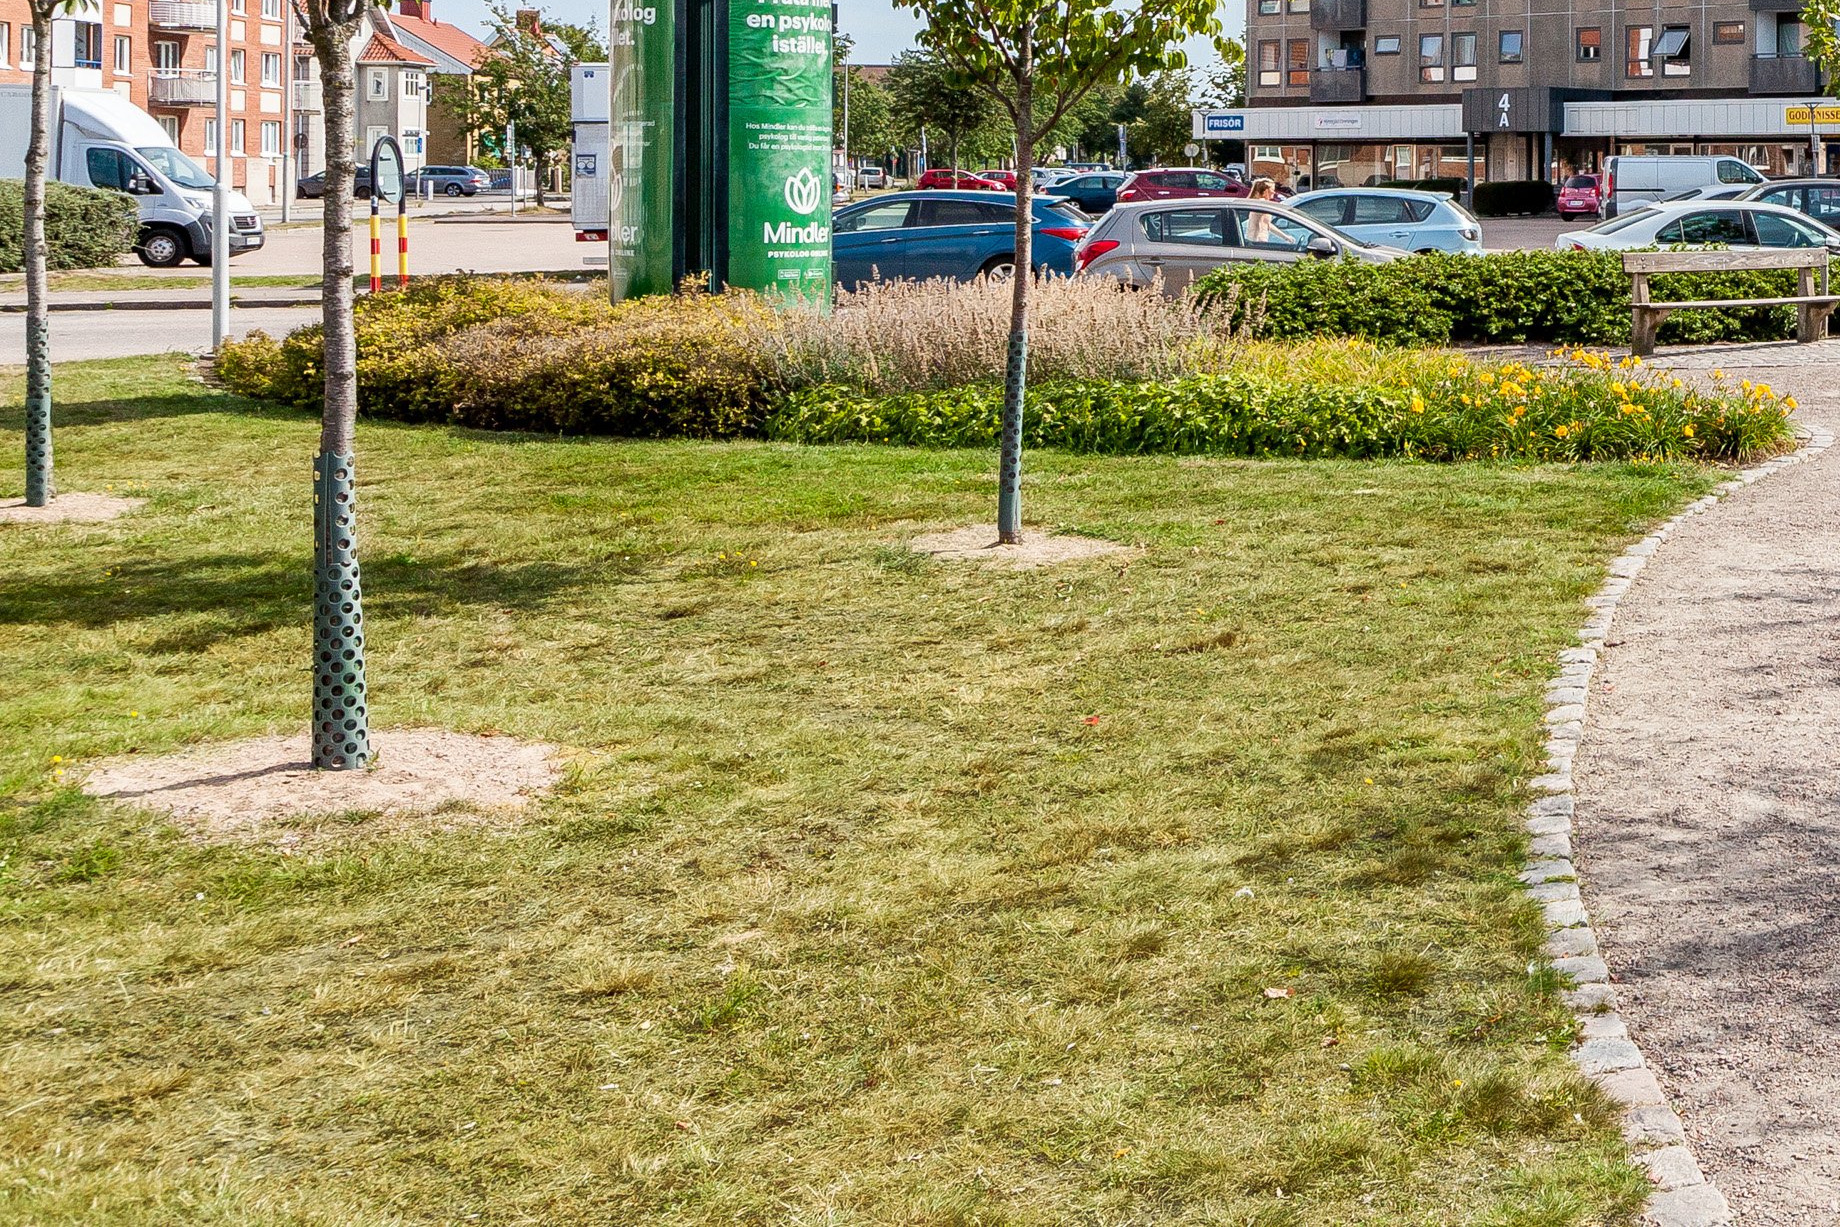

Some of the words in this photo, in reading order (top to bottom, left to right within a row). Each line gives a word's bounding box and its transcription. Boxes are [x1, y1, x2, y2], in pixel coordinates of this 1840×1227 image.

[746, 14, 775, 28] en
[1498, 93, 1511, 112] 4
[1208, 117, 1241, 128] FRISÖR
[1498, 112, 1509, 127] A
[748, 142, 759, 150] Du
[763, 221, 829, 244] Mindler
[767, 250, 810, 259] PSYKOLOG
